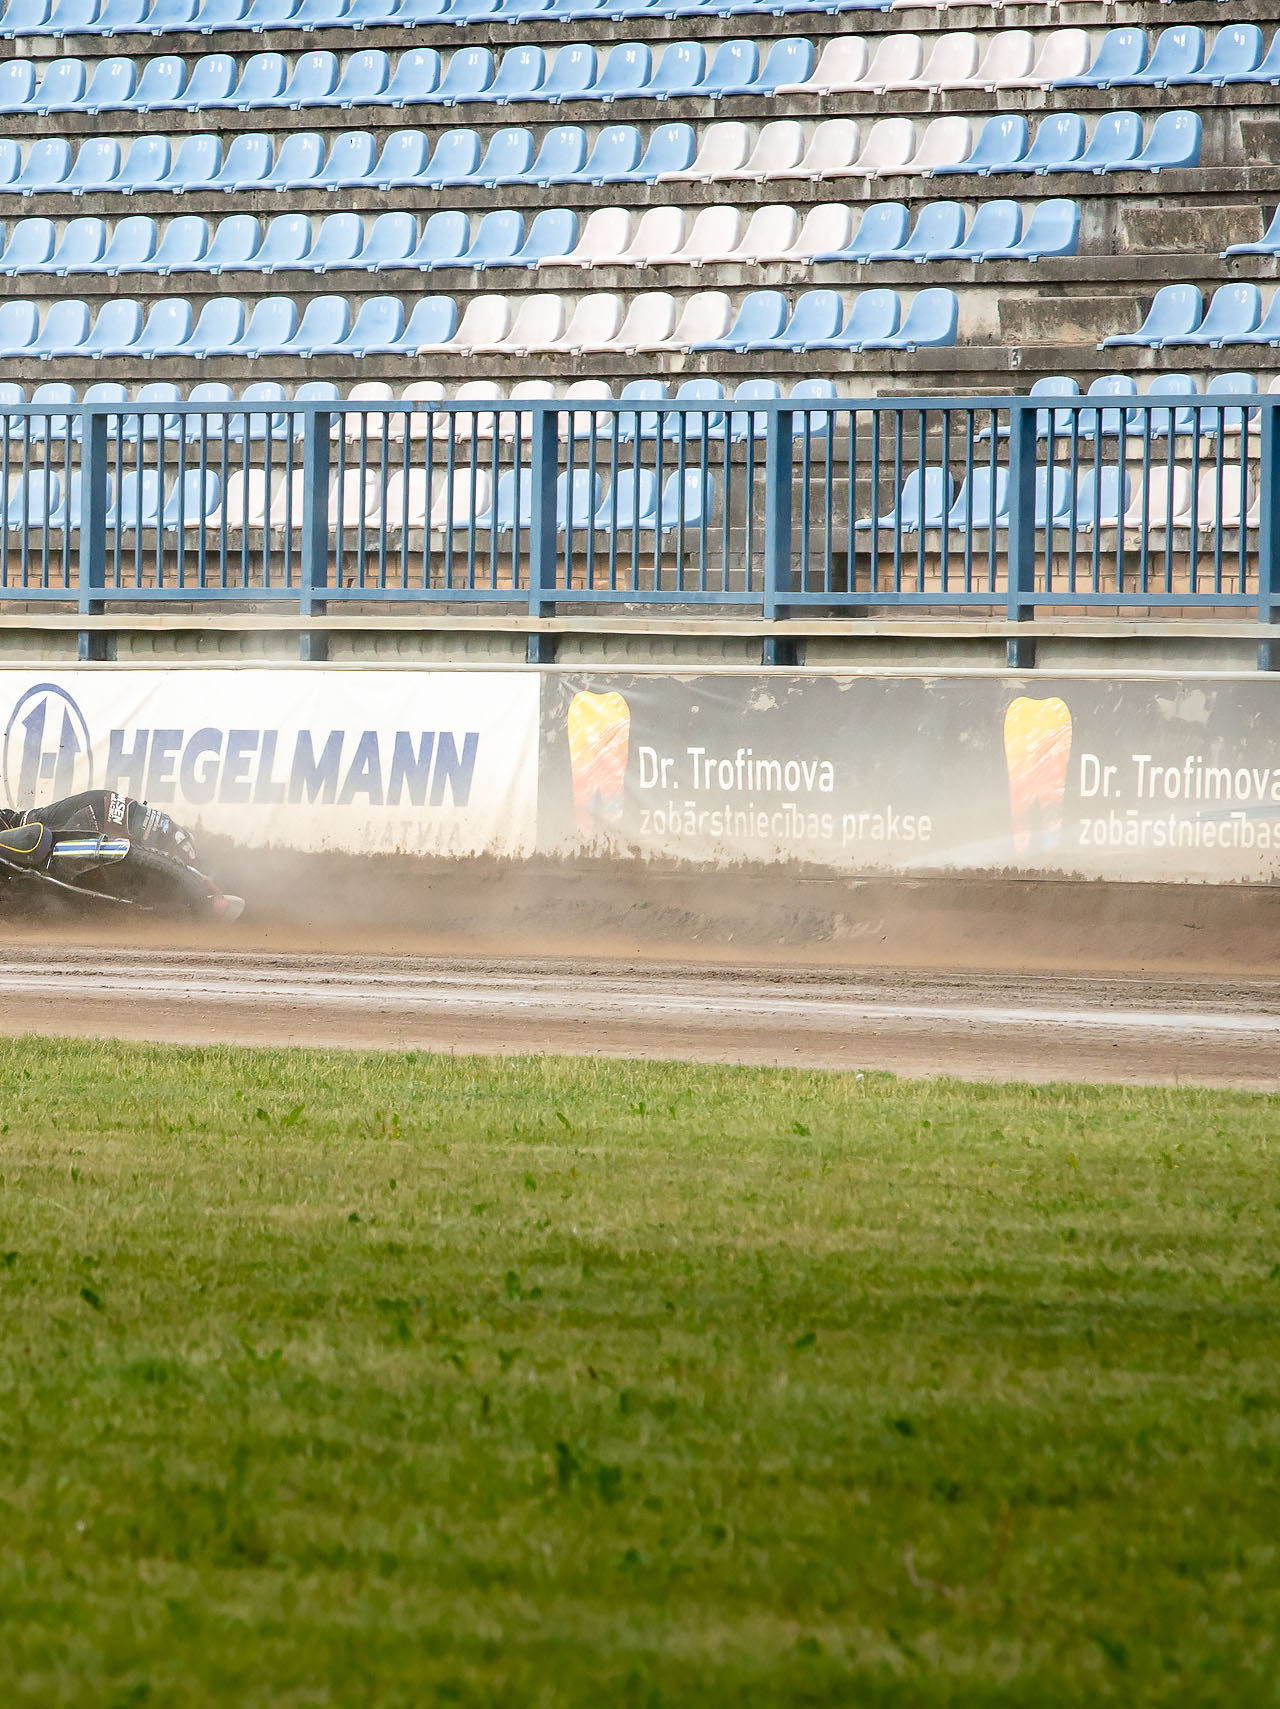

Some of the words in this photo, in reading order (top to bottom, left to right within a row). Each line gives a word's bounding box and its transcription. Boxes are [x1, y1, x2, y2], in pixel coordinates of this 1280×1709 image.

[105, 727, 480, 807] HEGELMANN
[638, 746, 679, 790] Dr.
[687, 747, 835, 793] Trofimova
[1079, 753, 1121, 798] Dr.
[1131, 754, 1280, 801] Trofimova
[639, 801, 833, 840] zobārstniecības
[841, 804, 933, 849] prakse
